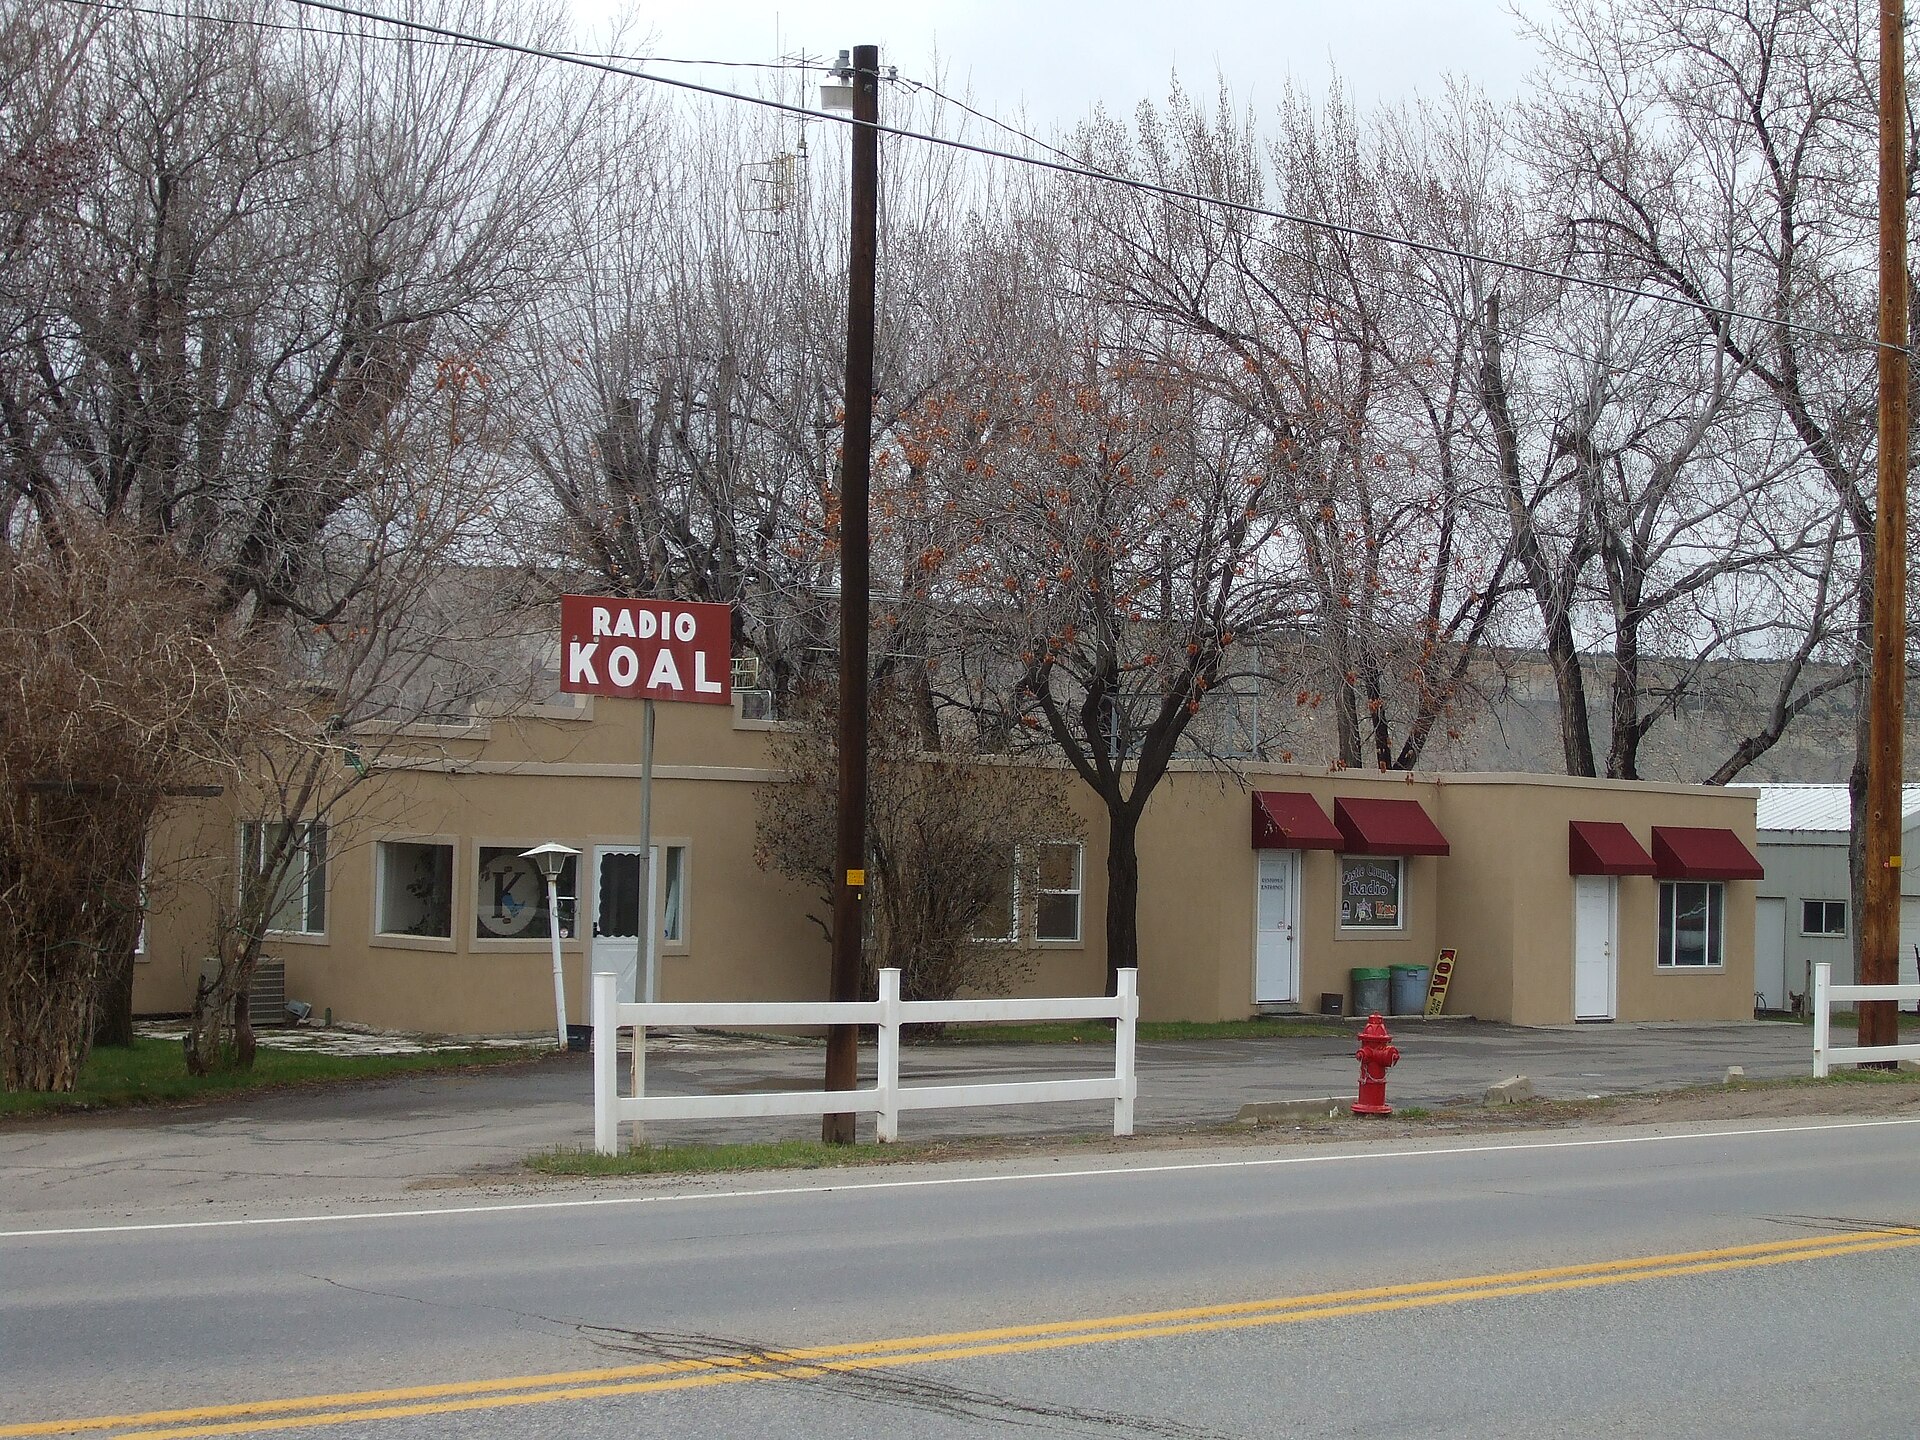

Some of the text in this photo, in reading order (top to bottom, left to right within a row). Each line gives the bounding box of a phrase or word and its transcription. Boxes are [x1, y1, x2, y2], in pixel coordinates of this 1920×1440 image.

[592, 606, 696, 642] RADIO
[569, 642, 722, 693] KOAL
[1349, 880, 1389, 896] Radio
[1430, 949, 1456, 997] KOAL
